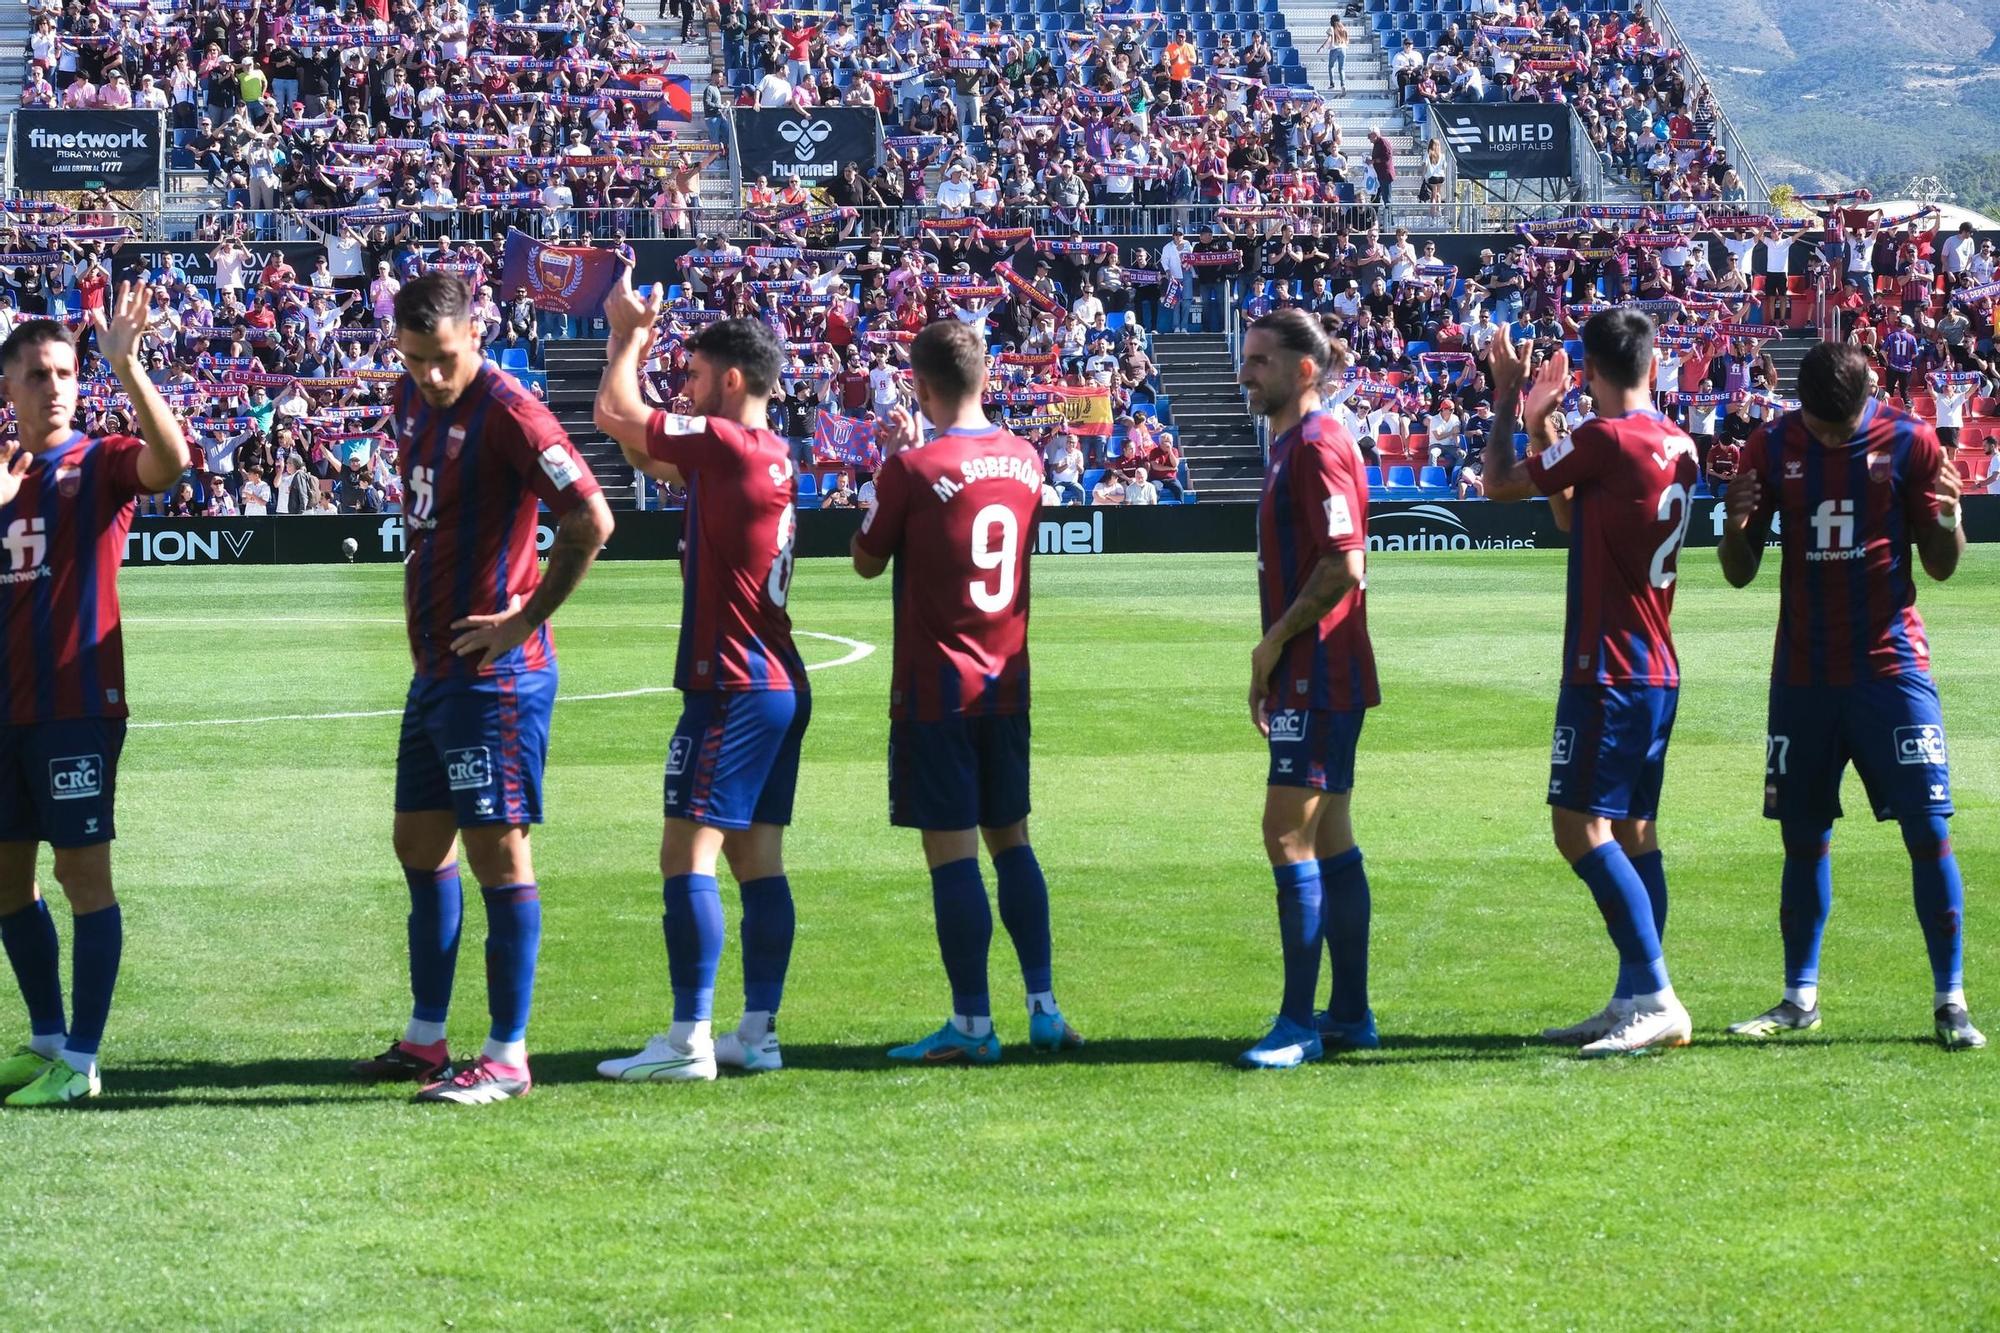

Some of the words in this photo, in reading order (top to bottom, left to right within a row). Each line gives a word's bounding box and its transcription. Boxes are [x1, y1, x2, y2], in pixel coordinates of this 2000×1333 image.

[305, 34, 337, 43] ELDENSE
[521, 60, 554, 69] ELDENSE
[550, 95, 567, 103] C.D.
[566, 95, 599, 104] ELDENSE
[619, 90, 663, 99] DEPORTIVO
[1078, 95, 1091, 103] C.D.
[462, 133, 496, 142] ELDENSE
[618, 129, 650, 138] ELDENSE
[1489, 123, 1555, 142] IMED
[28, 128, 148, 148] finetwork
[1489, 142, 1554, 154] HOSPITALES
[56, 150, 83, 159] FIBRA
[85, 150, 92, 159] Y
[52, 164, 71, 172] LLAMA
[71, 164, 92, 172] GRATIS
[100, 161, 123, 173] 1777
[772, 160, 838, 177] hummel
[496, 192, 530, 201] ELDENSE
[19, 201, 54, 209] ELDENSE
[1590, 207, 1606, 215] C.D.
[1607, 207, 1640, 215] ELDENSE
[808, 210, 841, 223] ELDENSE
[1663, 211, 1696, 223] ELDENSE
[21, 225, 38, 234] UPA
[1529, 218, 1578, 232] DEPORTIVO
[1051, 242, 1067, 250] C.D.
[1068, 243, 1100, 251] ELDENSE
[0, 254, 15, 265] UPA
[17, 253, 60, 265] DEPORTIVO
[693, 256, 708, 264] C.D.
[709, 255, 743, 264] ELDENSE
[1182, 254, 1199, 262] C.D.
[1200, 252, 1239, 262] ELDENSE
[922, 275, 937, 284] C.D.
[937, 276, 972, 284] ELDENSE
[1137, 273, 1157, 282] ELDENSE
[766, 280, 800, 289] ELDENSE
[1164, 283, 1179, 309] DENSE
[1970, 282, 2000, 300] DEPORTIV
[798, 295, 831, 303] ELDENSE
[342, 329, 375, 339] DEPORTI
[649, 341, 673, 355] DENSE
[784, 343, 810, 351] DENSE
[1894, 339, 1908, 356] 11
[215, 357, 250, 366] ELDENSE
[315, 378, 355, 386] DEPORTIVO
[1361, 384, 1396, 394] ELDENSE
[993, 393, 1013, 401] C.D.
[1013, 393, 1048, 401] ELDENSE
[1678, 394, 1695, 402] C.D.
[1695, 392, 1730, 402] ELDENSE
[1024, 414, 1061, 427] ELDENS
[932, 475, 964, 503] M.
[1810, 500, 1855, 550] fi
[2, 517, 47, 571] fi
[969, 503, 1019, 614] 9
[1806, 546, 1867, 562] network
[449, 762, 484, 781] CRC
[54, 768, 97, 790] CRC
